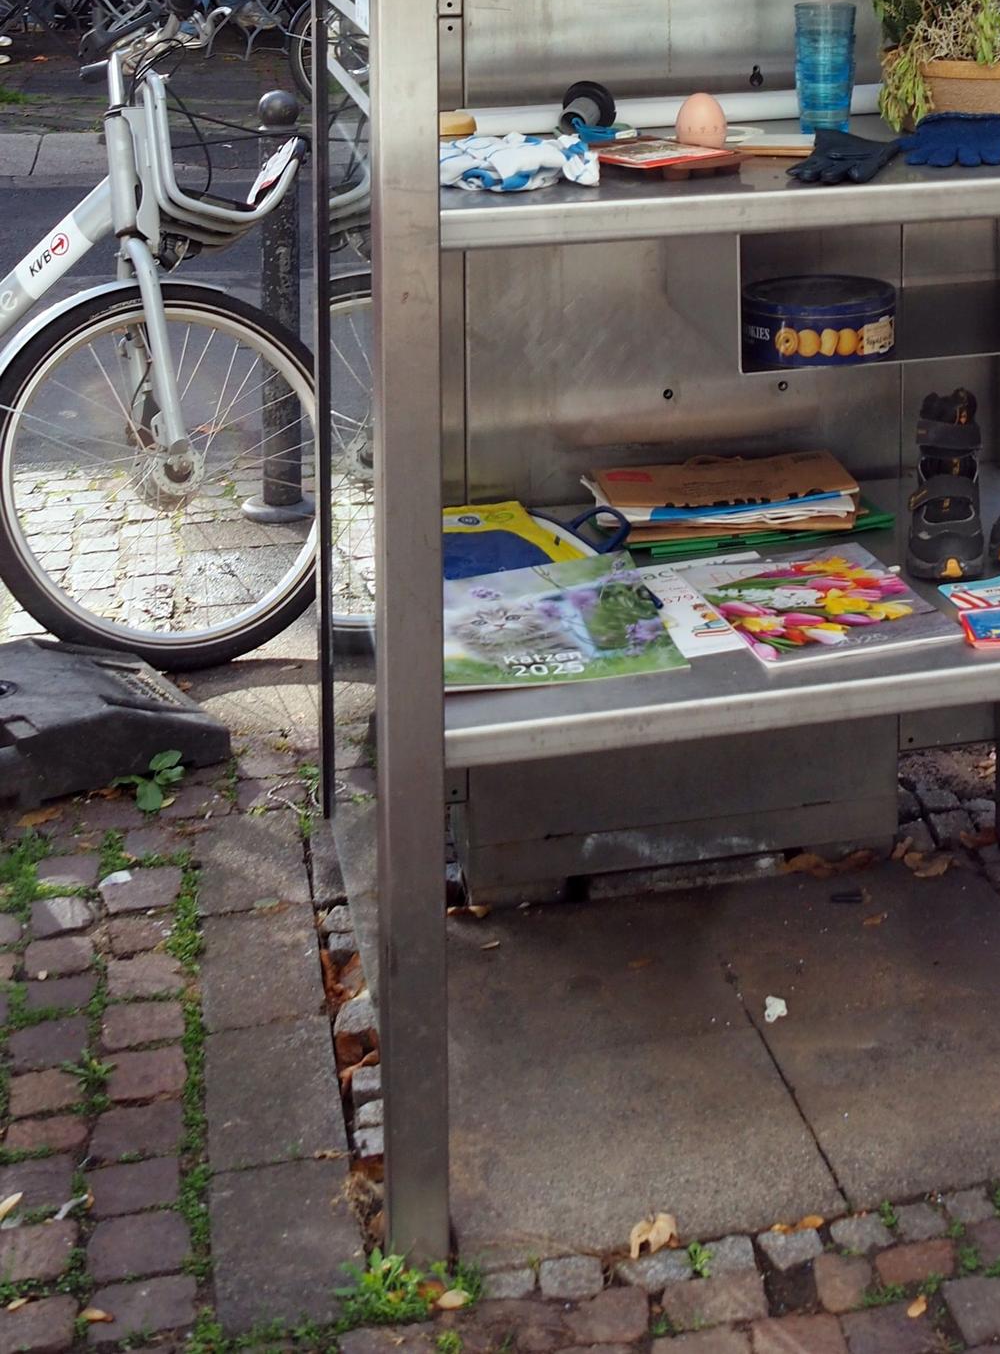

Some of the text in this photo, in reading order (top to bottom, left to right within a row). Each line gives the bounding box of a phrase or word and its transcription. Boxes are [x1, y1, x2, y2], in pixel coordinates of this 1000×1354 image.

[28, 249, 52, 277] KVB
[502, 650, 583, 666] Katzen
[511, 661, 585, 678] 2025
